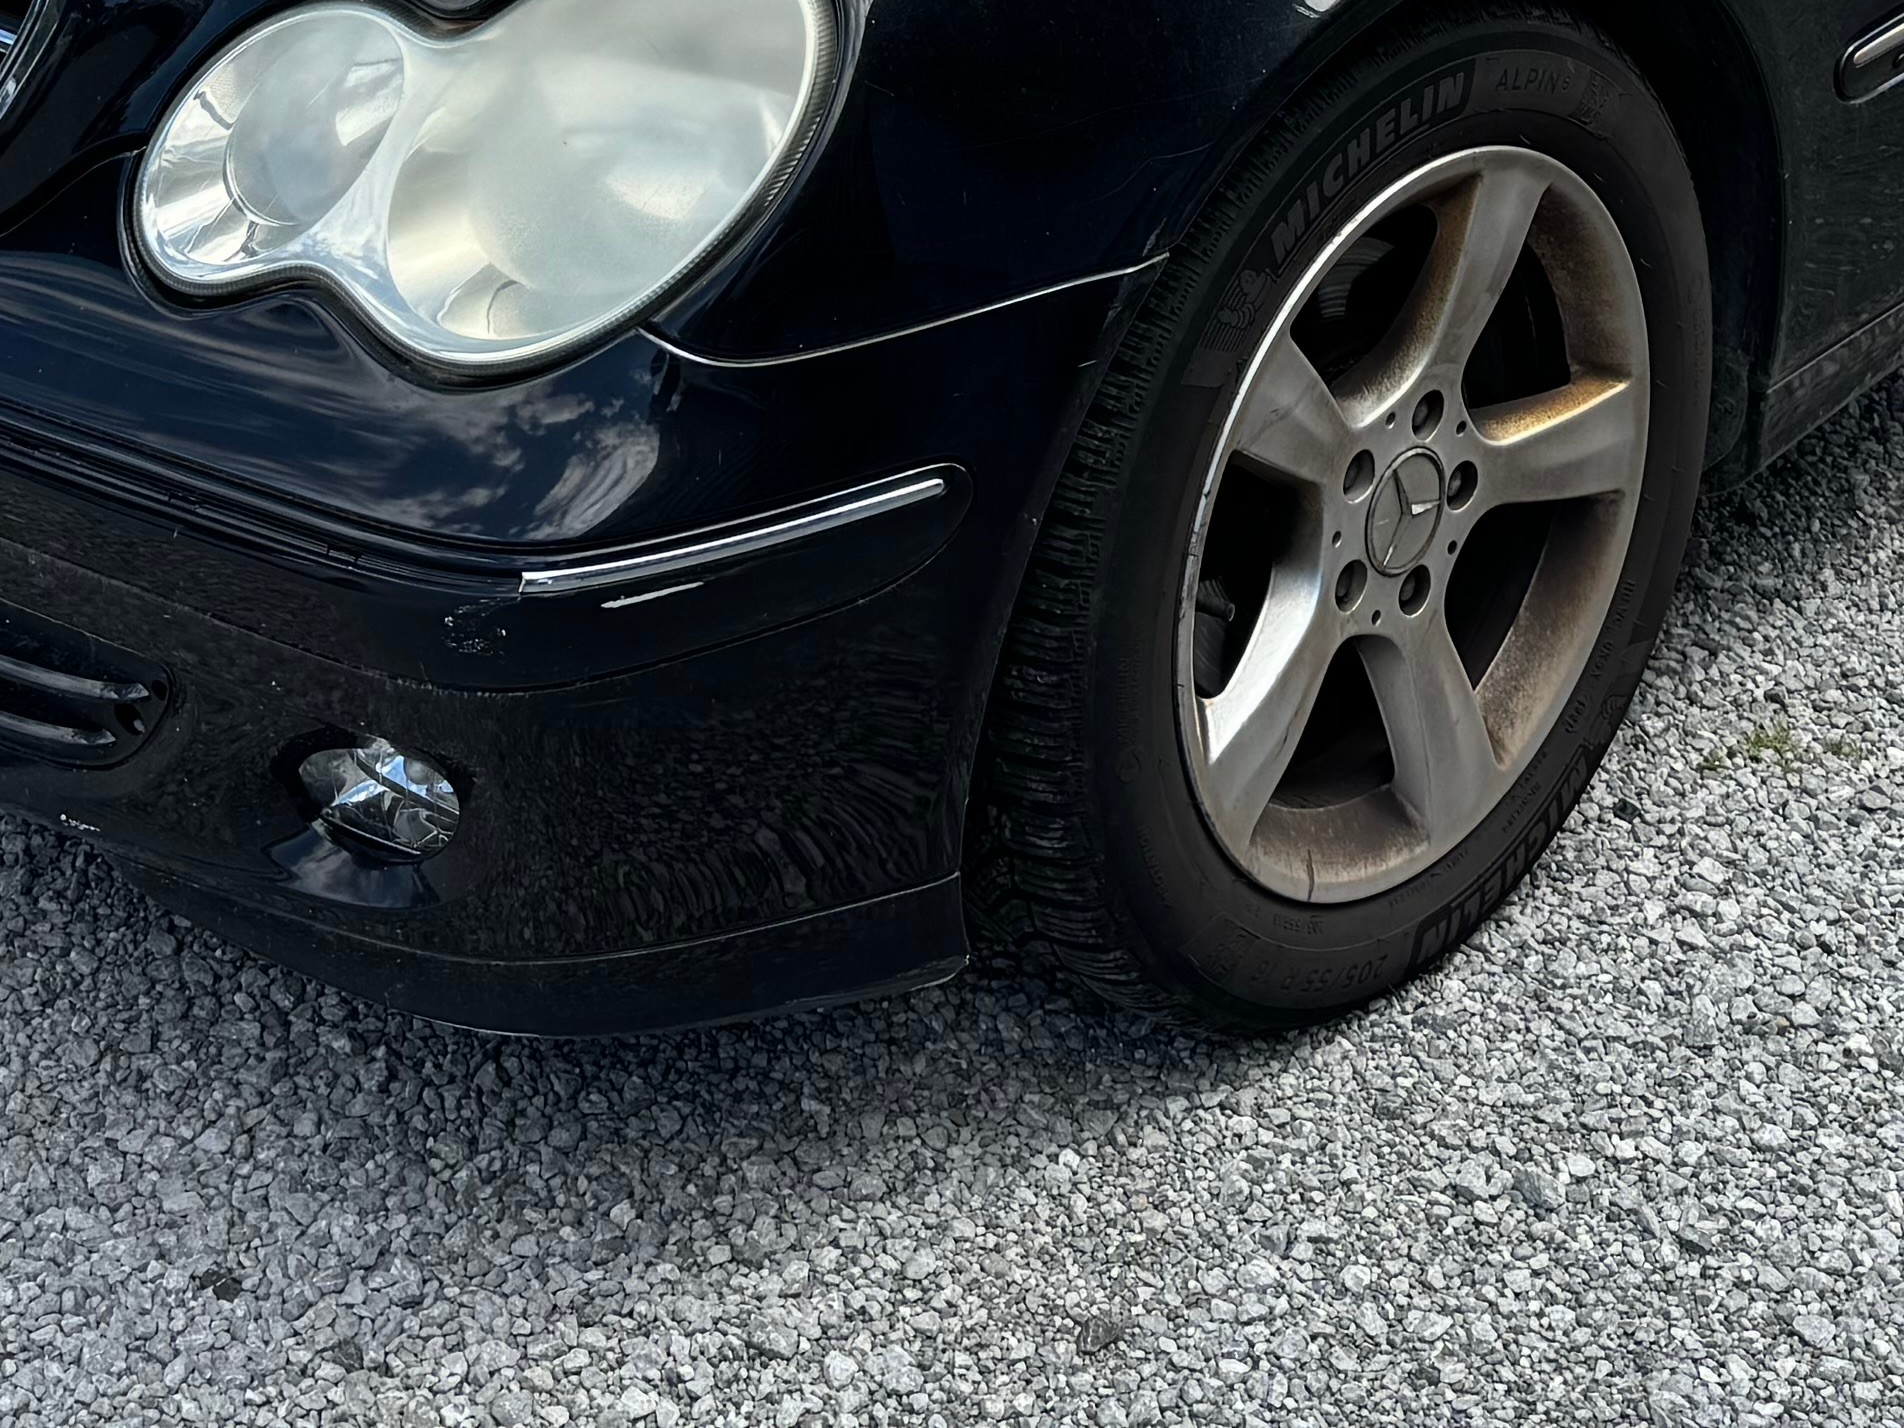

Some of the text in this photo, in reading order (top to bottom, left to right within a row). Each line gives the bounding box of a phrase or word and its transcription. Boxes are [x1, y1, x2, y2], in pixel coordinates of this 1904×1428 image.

[1494, 67, 1561, 95] ALPIN
[1270, 71, 1465, 265] MICHELIN
[1413, 750, 1589, 965] MICHELIN
[1299, 953, 1389, 994] 205/55
